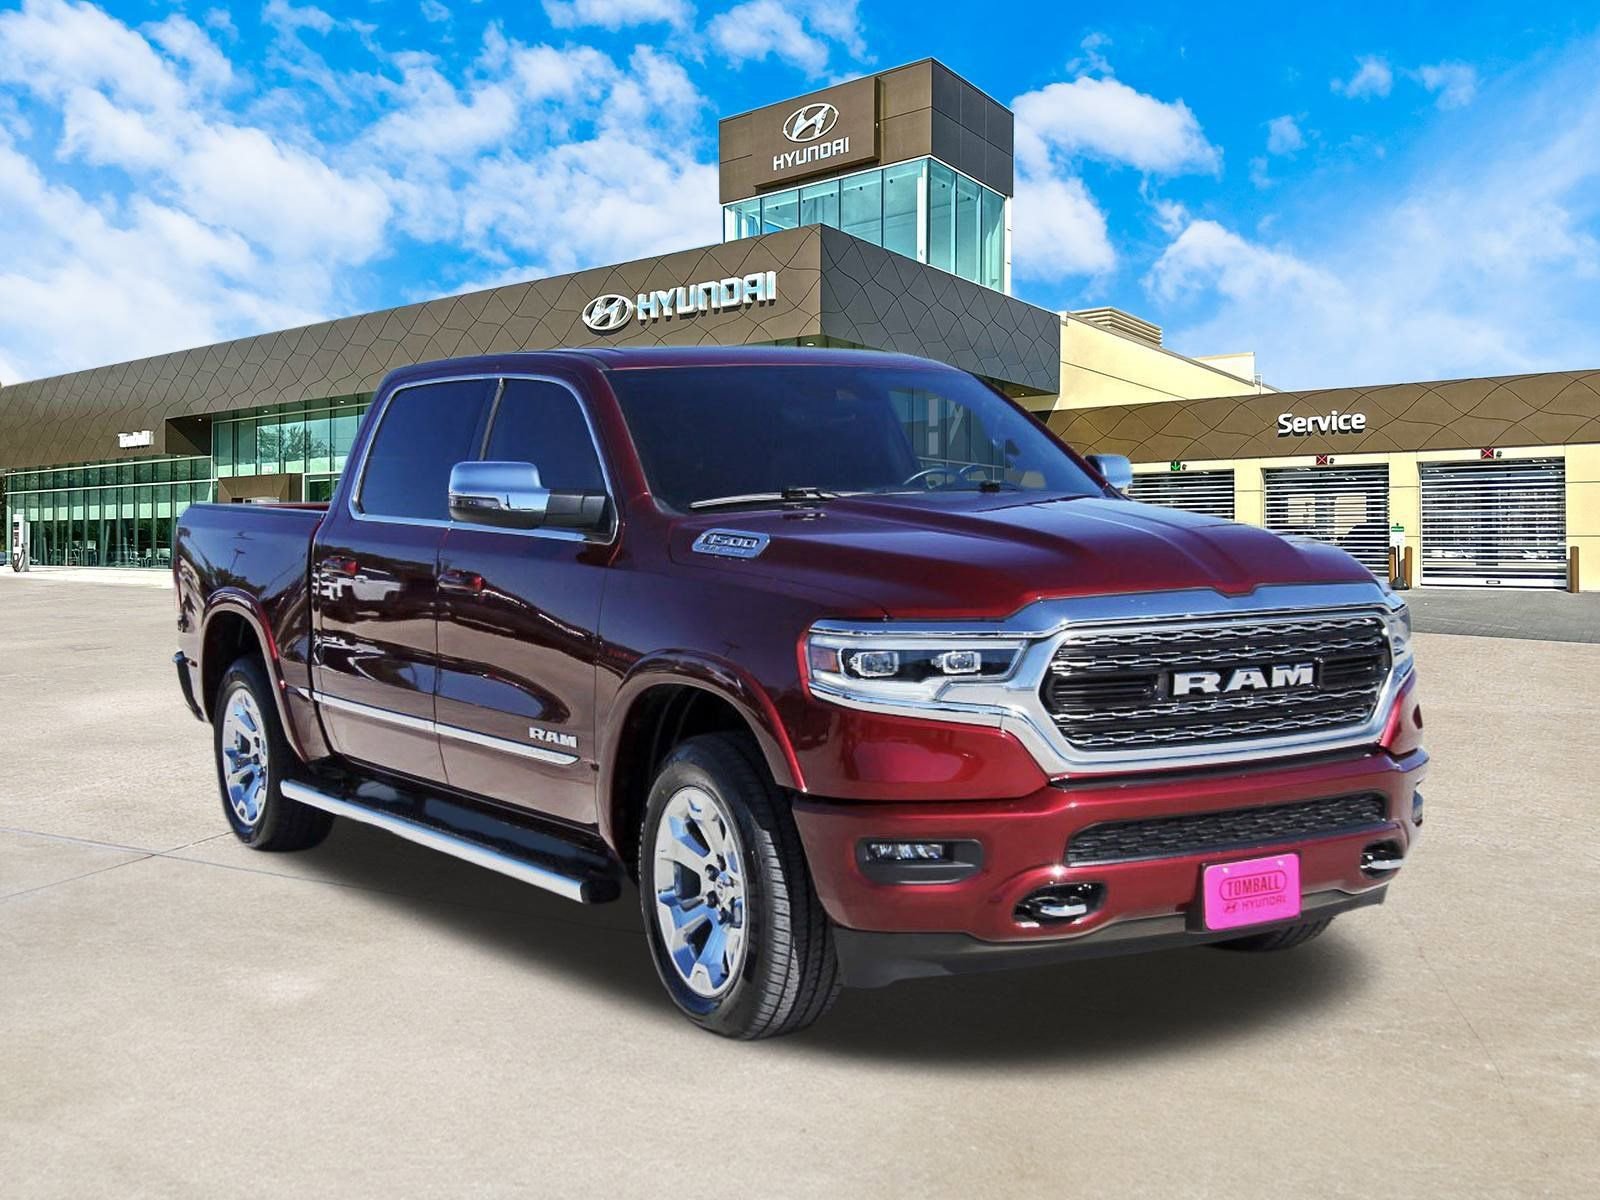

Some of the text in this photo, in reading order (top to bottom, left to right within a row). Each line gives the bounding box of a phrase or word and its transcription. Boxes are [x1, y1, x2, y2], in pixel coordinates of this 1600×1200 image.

[772, 136, 850, 171] HYUNDAI
[635, 271, 777, 321] HYUNDAI
[1277, 410, 1366, 434] Service
[707, 534, 758, 548] 1500
[1172, 662, 1314, 696] RAM
[528, 726, 577, 748] RAM
[1226, 874, 1281, 897] TOMBALL
[1241, 894, 1287, 912] HYUNDAI
